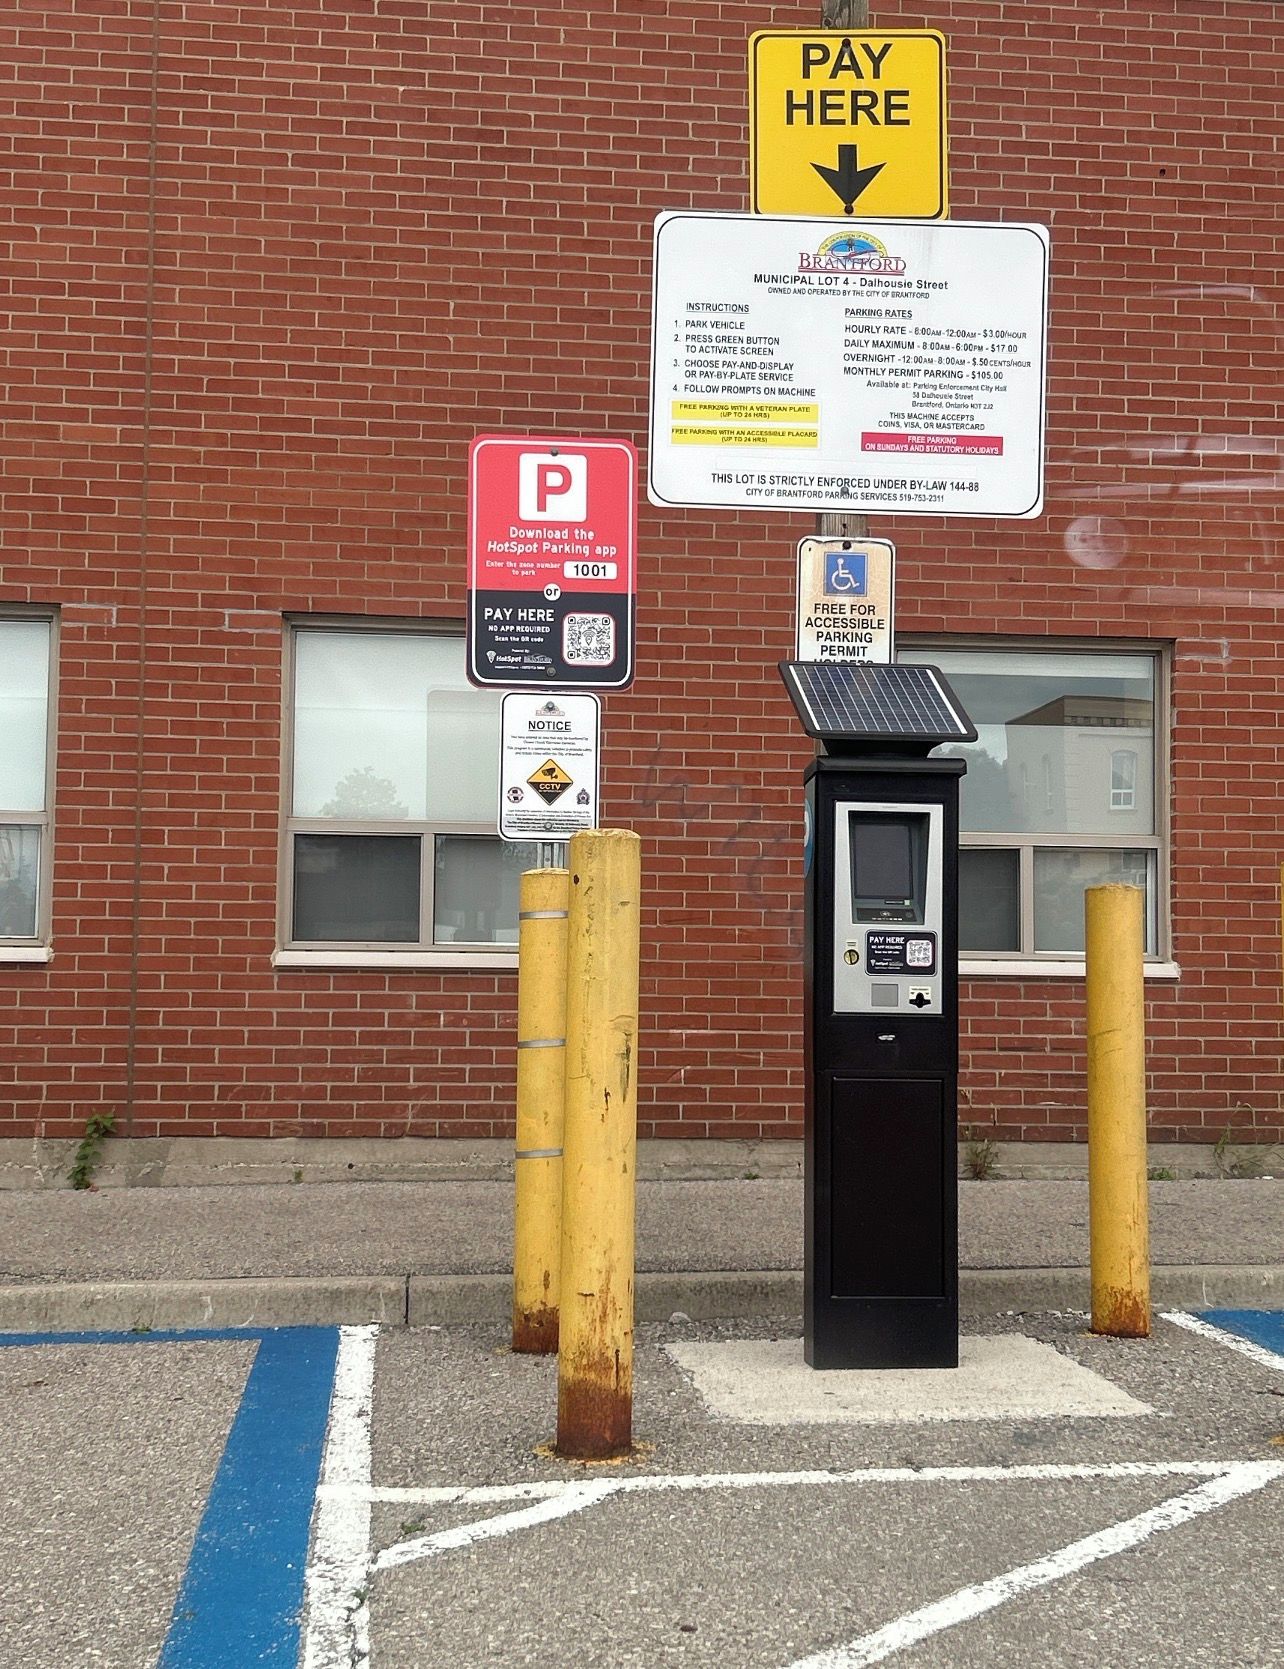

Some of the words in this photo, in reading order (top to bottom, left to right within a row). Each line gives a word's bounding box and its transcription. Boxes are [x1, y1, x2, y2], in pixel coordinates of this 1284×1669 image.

[802, 43, 893, 79] PAY
[786, 90, 910, 126] HERE
[799, 253, 906, 272] BRANTFORD
[754, 274, 814, 285] MUNICIPAL
[818, 276, 840, 286] LOT
[843, 277, 849, 286] 4
[860, 278, 913, 288] Dalhousie
[917, 280, 948, 290] Street
[808, 288, 841, 296] OPERATED
[891, 291, 929, 299] BRANTFORD
[686, 303, 749, 312] INSTRUCTIONS
[845, 308, 883, 317] PARKING
[885, 310, 913, 319] RATES
[685, 320, 708, 328] PARK
[710, 321, 745, 329] VEHICLE
[845, 325, 881, 334] HOURLY
[883, 326, 906, 334] RATE
[685, 334, 713, 343] PRESS
[715, 335, 743, 344] GREEN
[747, 337, 780, 345] BUTTON
[685, 345, 696, 353] TO
[699, 346, 738, 354] ACTIVATE
[740, 347, 773, 355] SCREEN
[844, 339, 870, 348] DAILY
[872, 340, 915, 349] MAXIMUM
[991, 344, 1018, 353] $17.00
[843, 353, 896, 363] OVERNIGHT
[685, 359, 720, 368] CHOOSE
[722, 361, 794, 370] PAY-AND-DISPLAY
[685, 370, 696, 378] OR
[699, 371, 756, 380] PAY-BY-PLATE
[758, 373, 794, 381] SERVICE
[843, 367, 886, 376] MONTHLY
[889, 368, 921, 377] PERMIT
[924, 370, 963, 379] PARKING
[971, 371, 1003, 379] $105.00
[684, 385, 719, 393] FOLLOW
[722, 386, 761, 394] PROMPTS
[764, 387, 776, 395] ON
[778, 387, 816, 396] MACHINE
[866, 380, 899, 388] Available
[913, 383, 937, 392] Parking
[939, 383, 979, 391] Enforcement
[981, 385, 993, 393] City
[537, 464, 572, 512] P
[712, 473, 733, 483] THIS
[736, 474, 756, 484] LOT
[757, 475, 766, 484] IS
[769, 475, 814, 487] STRICTLY
[817, 477, 871, 488] ENFORCED
[873, 479, 907, 489] UNDER
[910, 480, 947, 491] BY-LAW
[950, 482, 979, 491] 144-88
[746, 488, 762, 496] CITY
[776, 489, 823, 498] BRANTFORD
[860, 492, 897, 501] SERVICES
[510, 527, 568, 539] Download
[574, 528, 594, 540] the
[487, 541, 538, 555] HotSpot
[542, 542, 589, 556] Parking
[595, 546, 617, 557] app
[573, 564, 607, 576] 1001
[546, 587, 558, 596] or
[484, 608, 513, 621] PAY
[518, 609, 554, 621] HERE
[814, 603, 846, 614] FREE
[851, 605, 876, 615] FOR
[805, 617, 884, 629] ACCESSIBLE
[817, 631, 872, 643] PARKING
[820, 645, 868, 657] PERMIT
[529, 721, 571, 731] NOTICE
